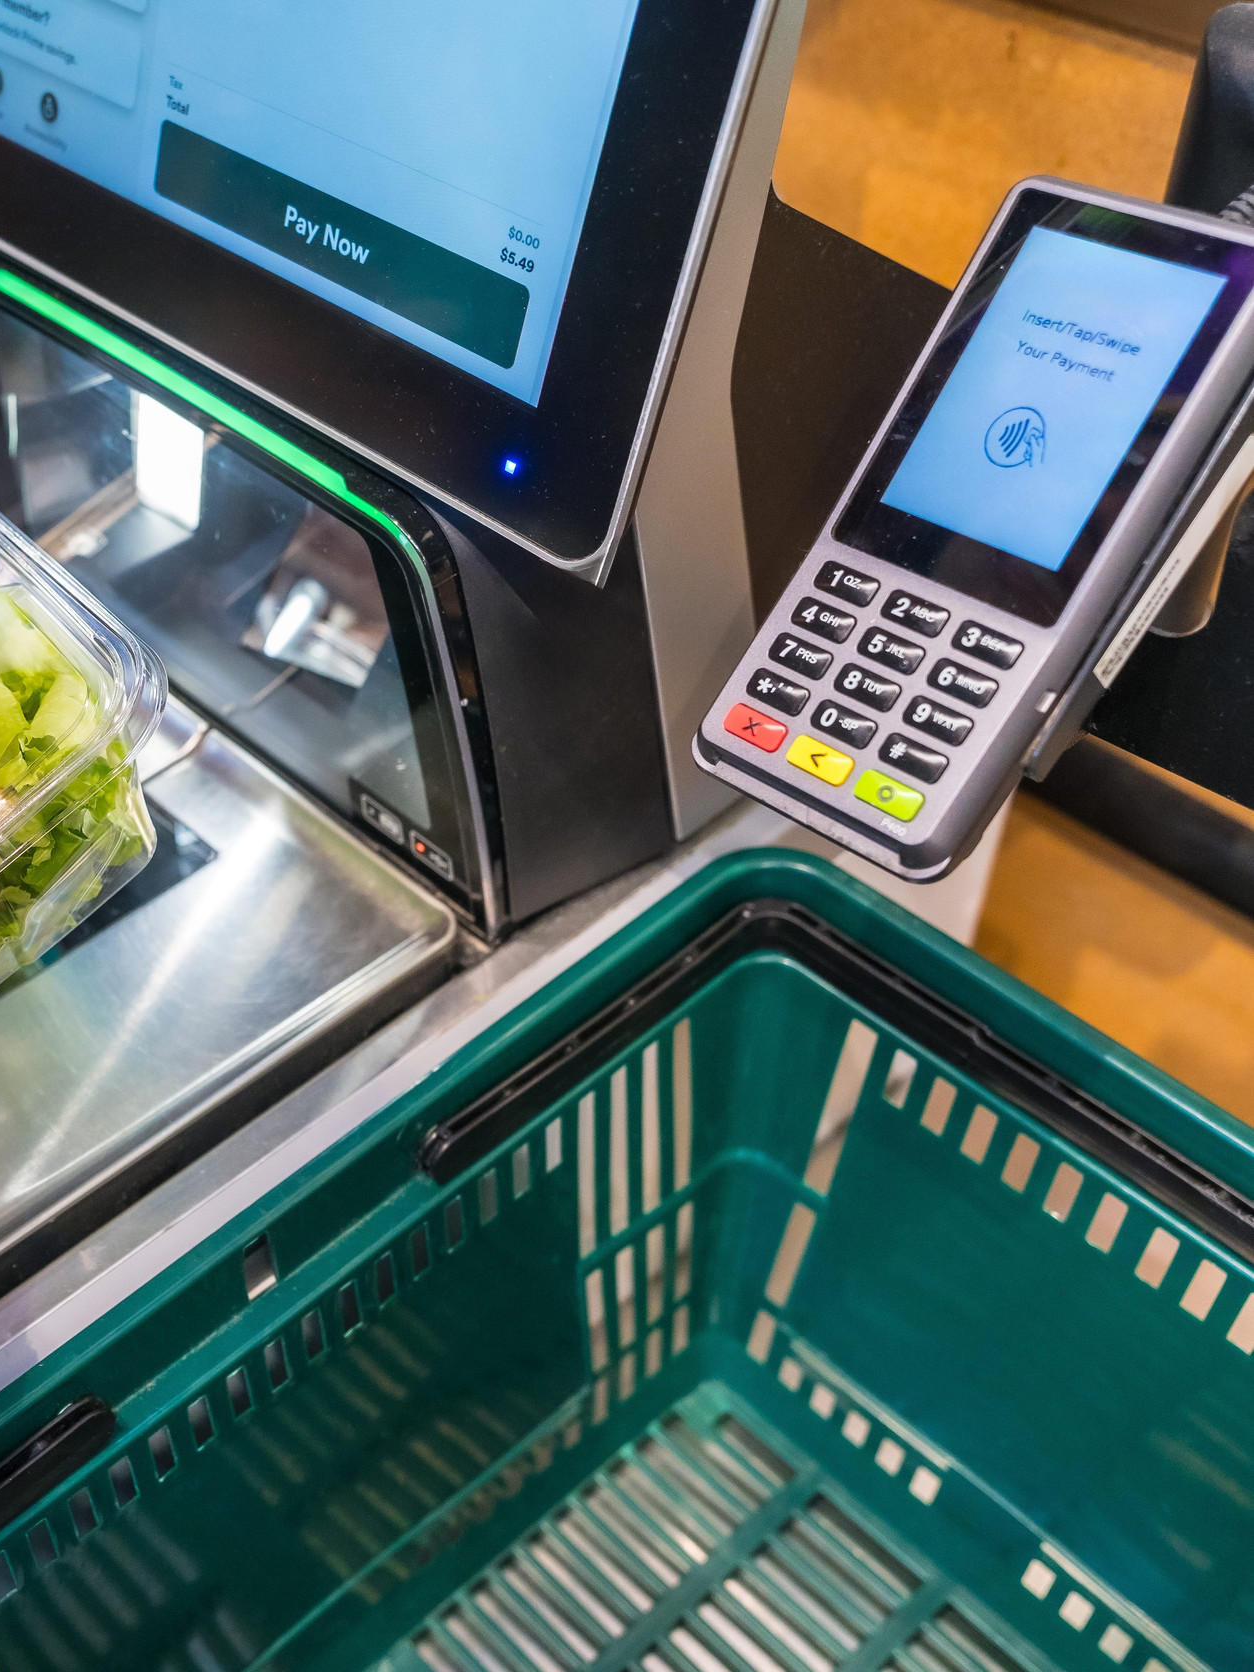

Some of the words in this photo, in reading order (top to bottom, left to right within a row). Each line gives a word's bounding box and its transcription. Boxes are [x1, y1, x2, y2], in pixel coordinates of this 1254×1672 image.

[169, 75, 183, 90] Tax
[166, 94, 190, 116] Total
[284, 204, 319, 244] Pay
[322, 223, 370, 265] Now
[508, 225, 540, 249] $0.00
[500, 247, 535, 272] $5.49
[1022, 310, 1141, 356] Insert/Tap/Swipe
[1017, 340, 1048, 360] Your
[1049, 351, 1114, 382] Payment
[830, 569, 845, 587] 1
[801, 605, 819, 623] 4
[819, 612, 841, 628] GHI
[891, 597, 911, 618] 2
[910, 605, 935, 623] ABC
[867, 634, 887, 654] 5
[885, 643, 905, 659] JKL
[961, 626, 982, 648] 3
[779, 639, 797, 658] 7
[796, 647, 818, 664] PRS
[843, 670, 863, 690] 8
[862, 678, 885, 696] TUV
[937, 666, 958, 686] 6
[820, 708, 838, 727] 0
[912, 703, 932, 723] 9
